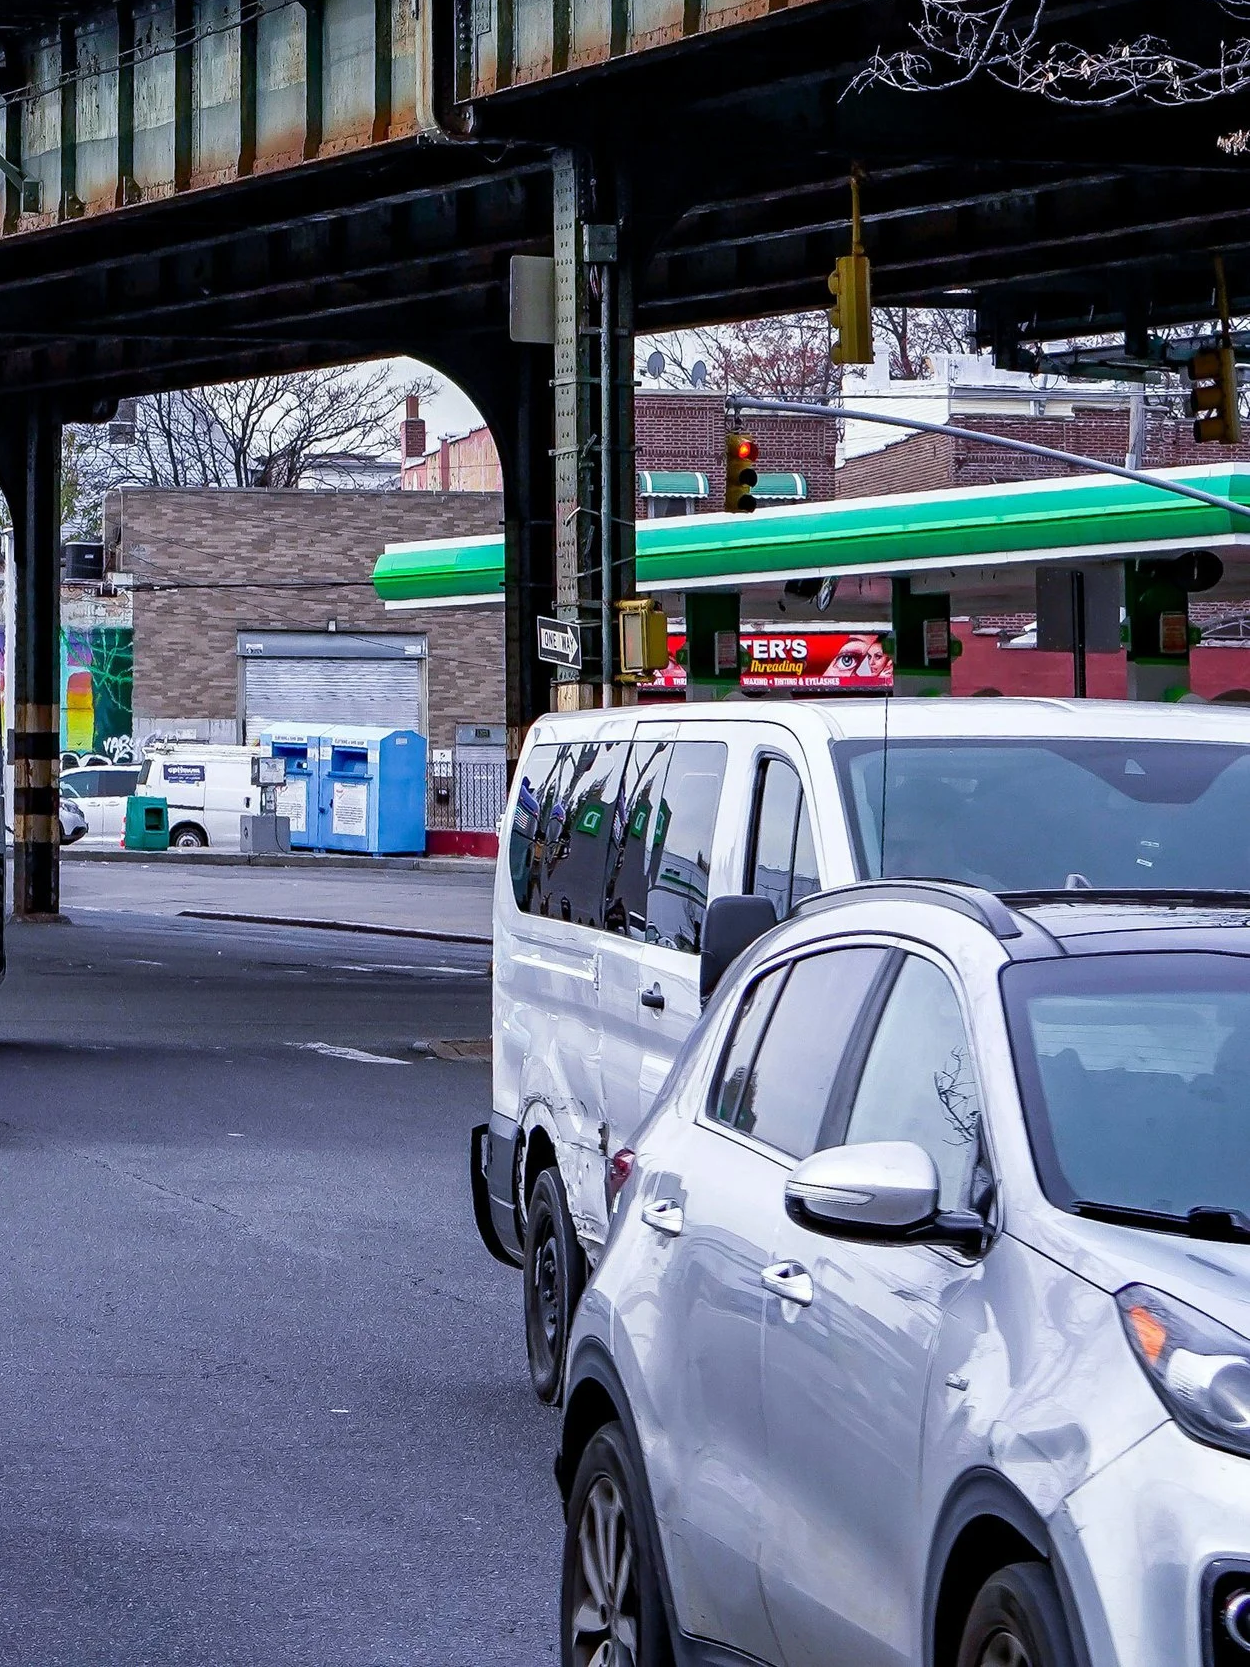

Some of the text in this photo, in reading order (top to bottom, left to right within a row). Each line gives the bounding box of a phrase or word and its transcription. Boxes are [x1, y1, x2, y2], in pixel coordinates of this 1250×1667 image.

[544, 631, 574, 653] ONE WAY
[751, 660, 803, 675] Threading
[805, 677, 840, 685] EYELASHES
